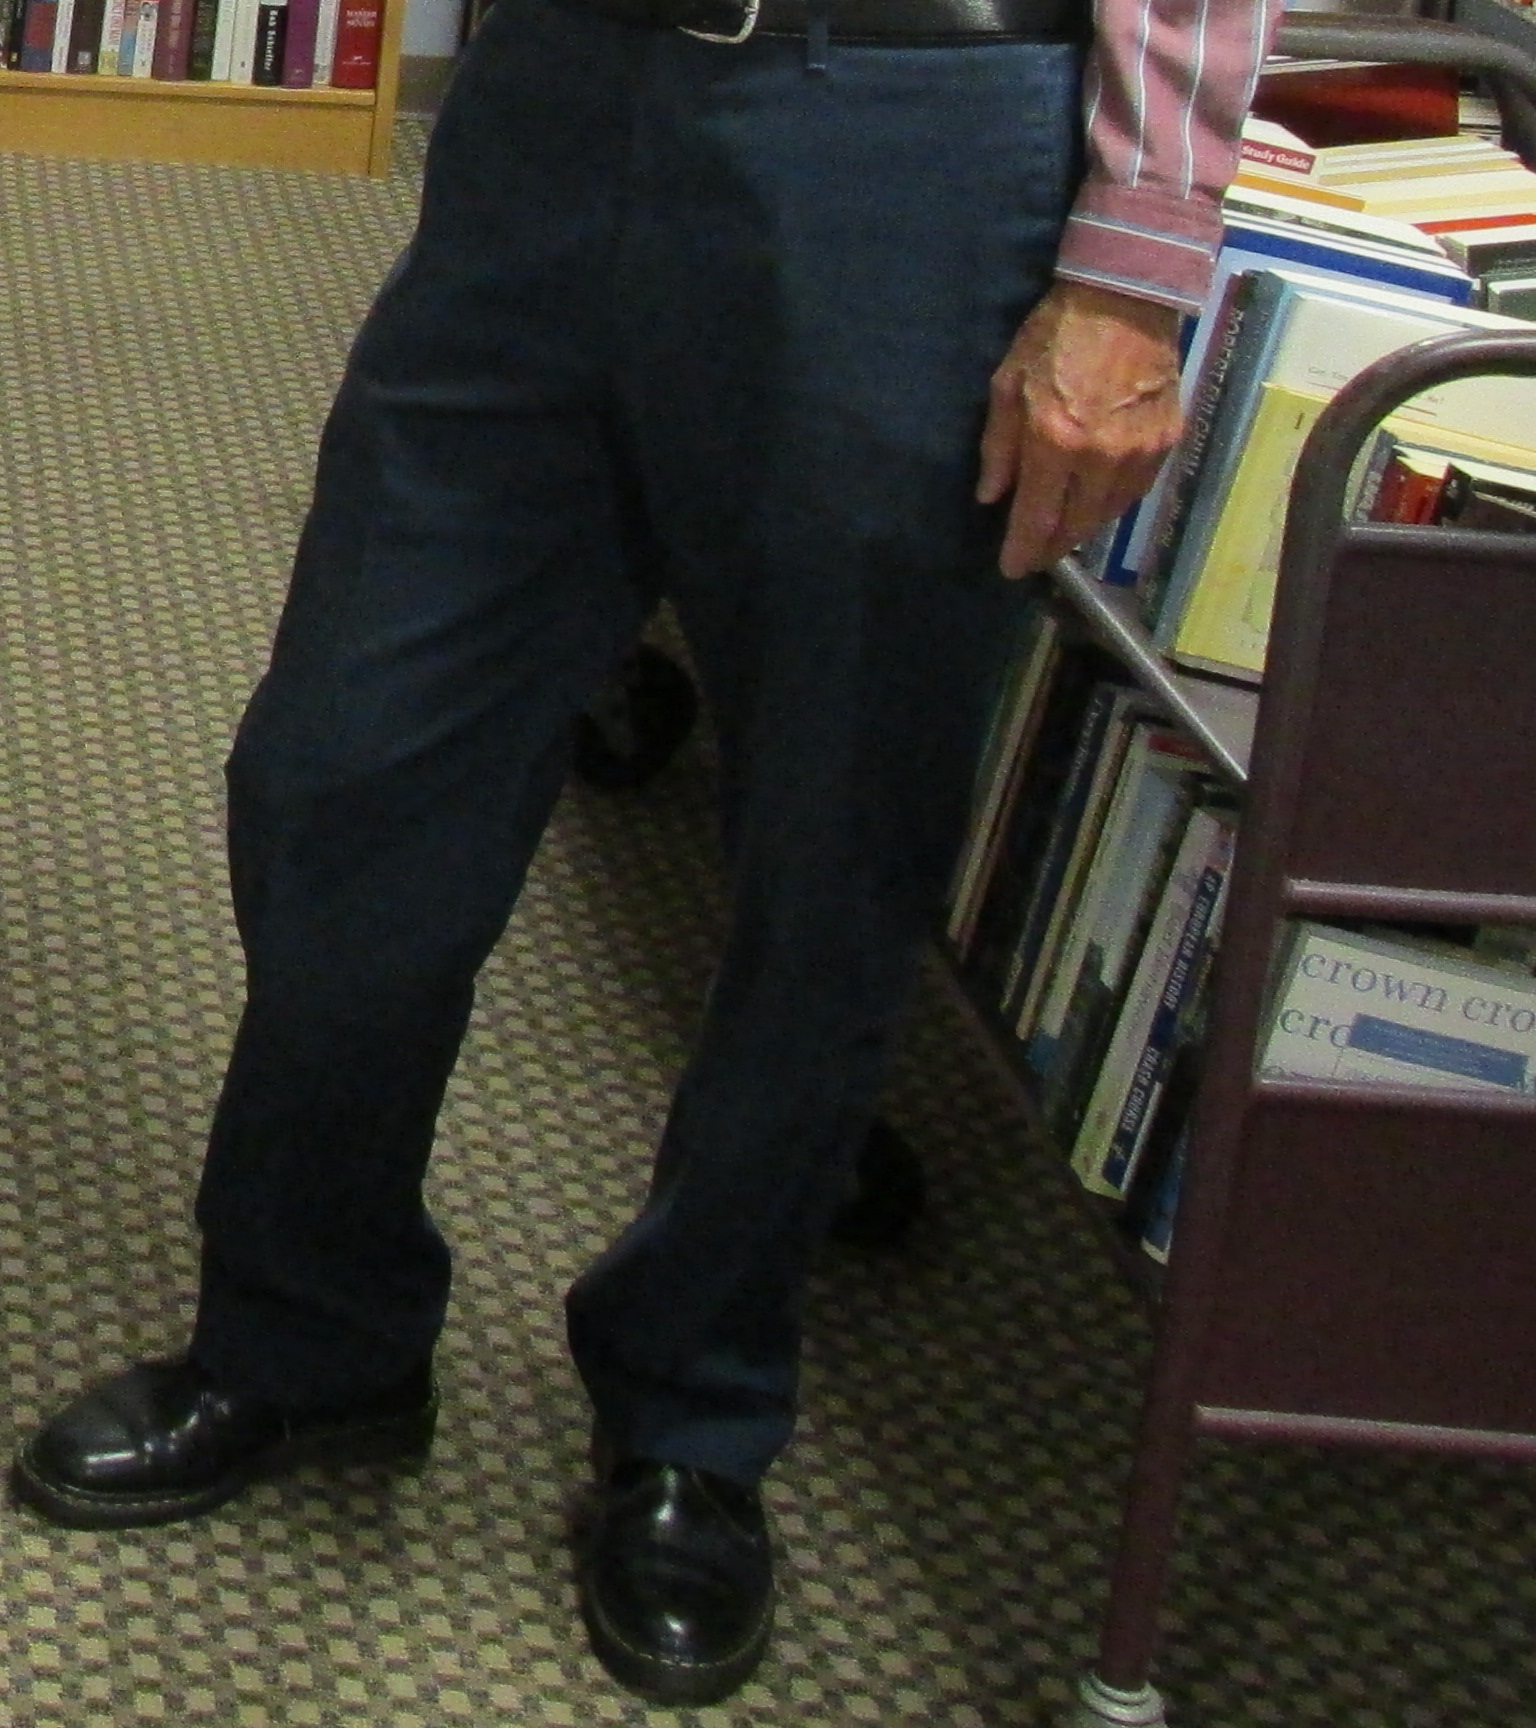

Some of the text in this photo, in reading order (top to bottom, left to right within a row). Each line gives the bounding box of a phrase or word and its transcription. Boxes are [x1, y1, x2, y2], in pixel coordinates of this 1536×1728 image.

[1242, 144, 1311, 173] Study Guide
[1303, 952, 1447, 1013] crown
